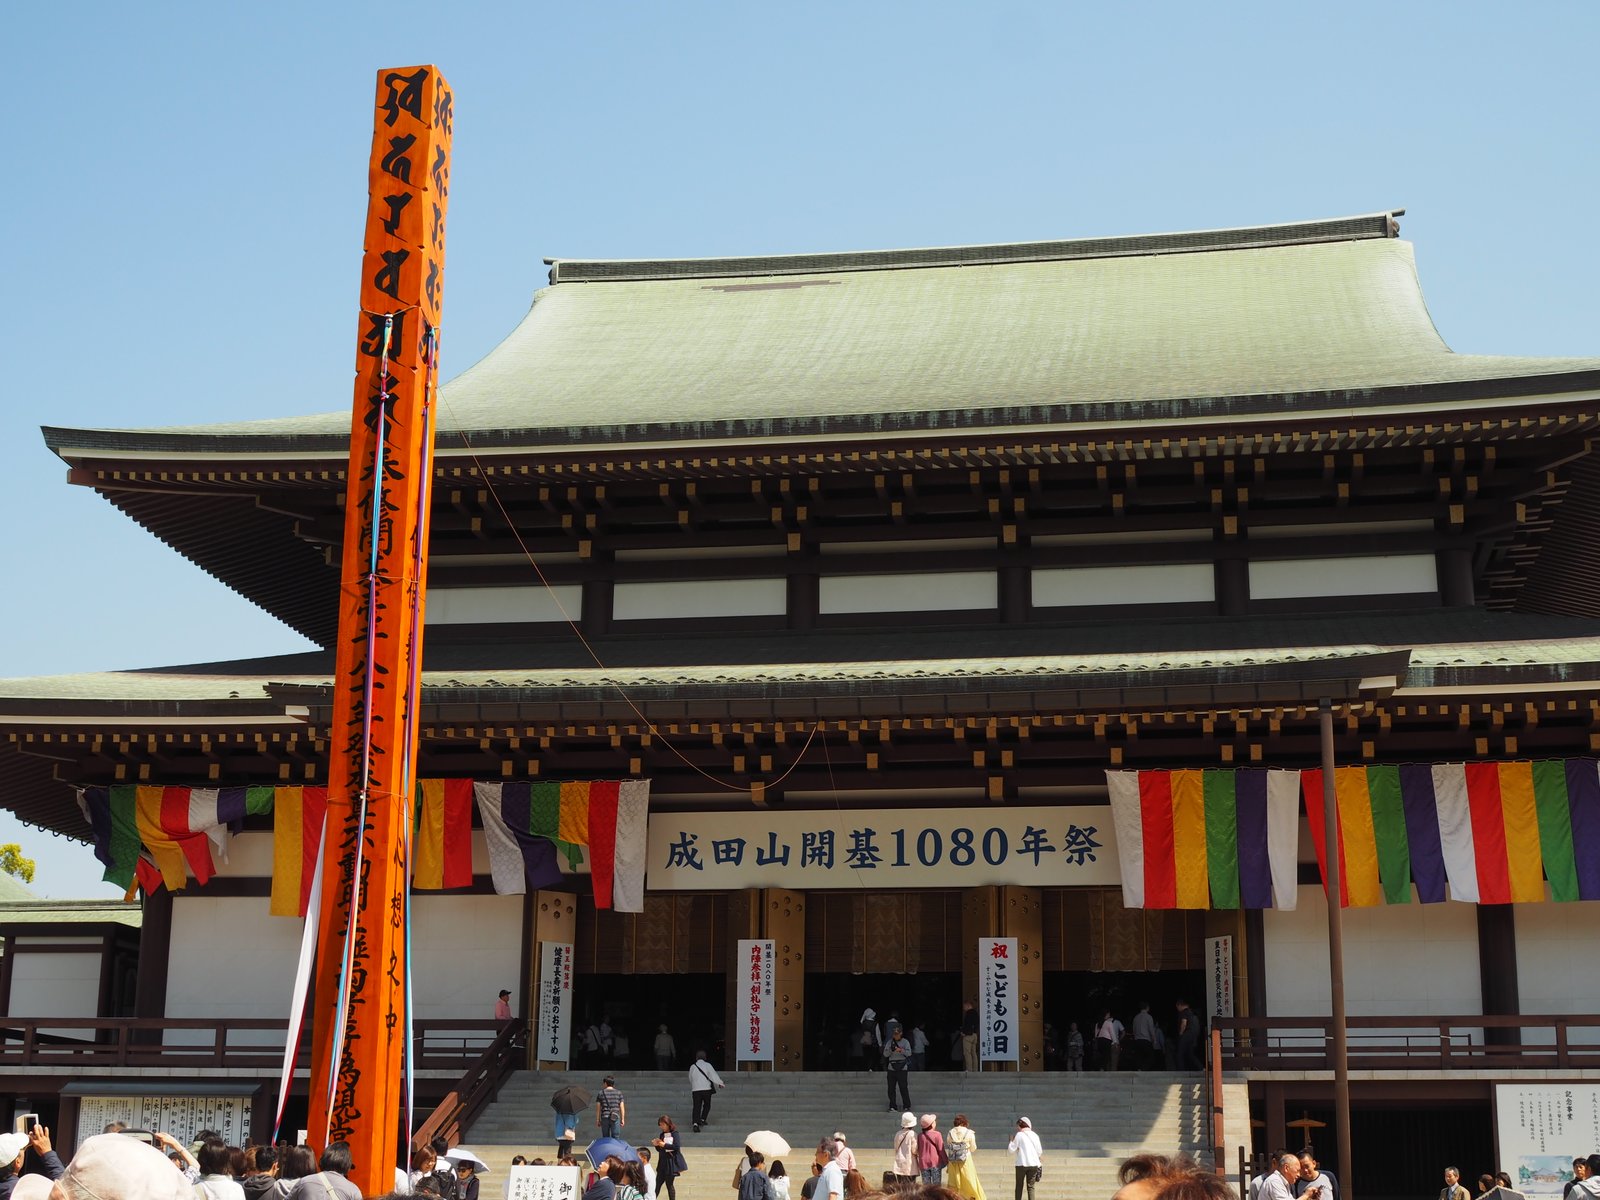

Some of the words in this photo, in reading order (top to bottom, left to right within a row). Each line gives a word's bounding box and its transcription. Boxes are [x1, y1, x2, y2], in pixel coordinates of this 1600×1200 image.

[665, 824, 1104, 871] 成田山開基1080年祭
[991, 942, 1008, 959] 祝
[551, 946, 563, 1055] 健康長寿祈願のおすすめ
[1214, 940, 1222, 1017] 東日本大震災被災地
[993, 963, 1008, 1054] こどもの日
[1565, 1090, 1573, 1120] 記念事業
[559, 1182, 573, 1200] 御
